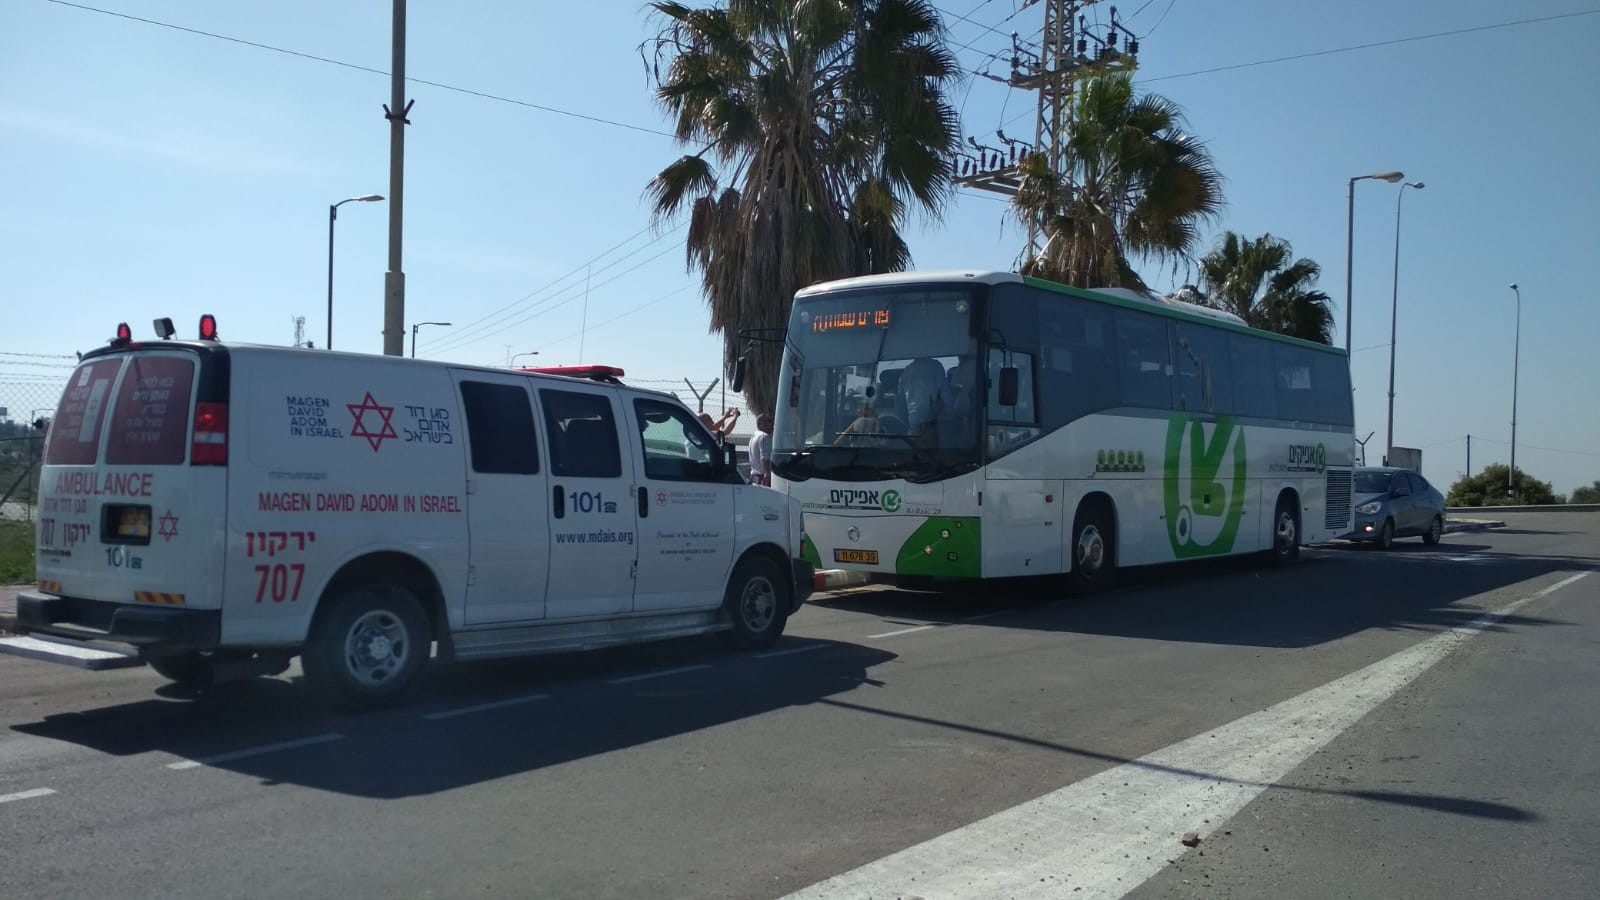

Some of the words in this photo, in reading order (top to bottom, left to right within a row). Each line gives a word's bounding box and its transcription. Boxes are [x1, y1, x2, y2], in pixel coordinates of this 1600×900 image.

[286, 395, 330, 407] MAGEN
[288, 406, 324, 417] DAVID
[404, 405, 425, 418] דוד
[430, 408, 450, 420] מגן
[290, 417, 328, 428] ADOM
[418, 419, 450, 432] אדום
[290, 427, 303, 437] IN
[306, 427, 344, 439] ISRAEL
[403, 428, 453, 444] בישראל
[1288, 444, 1316, 467] אפיקים
[55, 472, 154, 497] AMBULANCE
[258, 492, 311, 512] MAGEN
[316, 493, 355, 512] DAVID
[360, 494, 398, 512] ADOM
[404, 495, 416, 512] IN
[420, 495, 462, 513] ISRAEL
[569, 490, 602, 514] 101
[830, 489, 879, 507] אפיקים
[41, 517, 55, 545] 707
[64, 523, 91, 547] ירקון
[555, 528, 634, 545] www.mdais.org
[245, 531, 316, 558] ירקון
[105, 545, 130, 569] 101
[255, 563, 305, 604] 707
